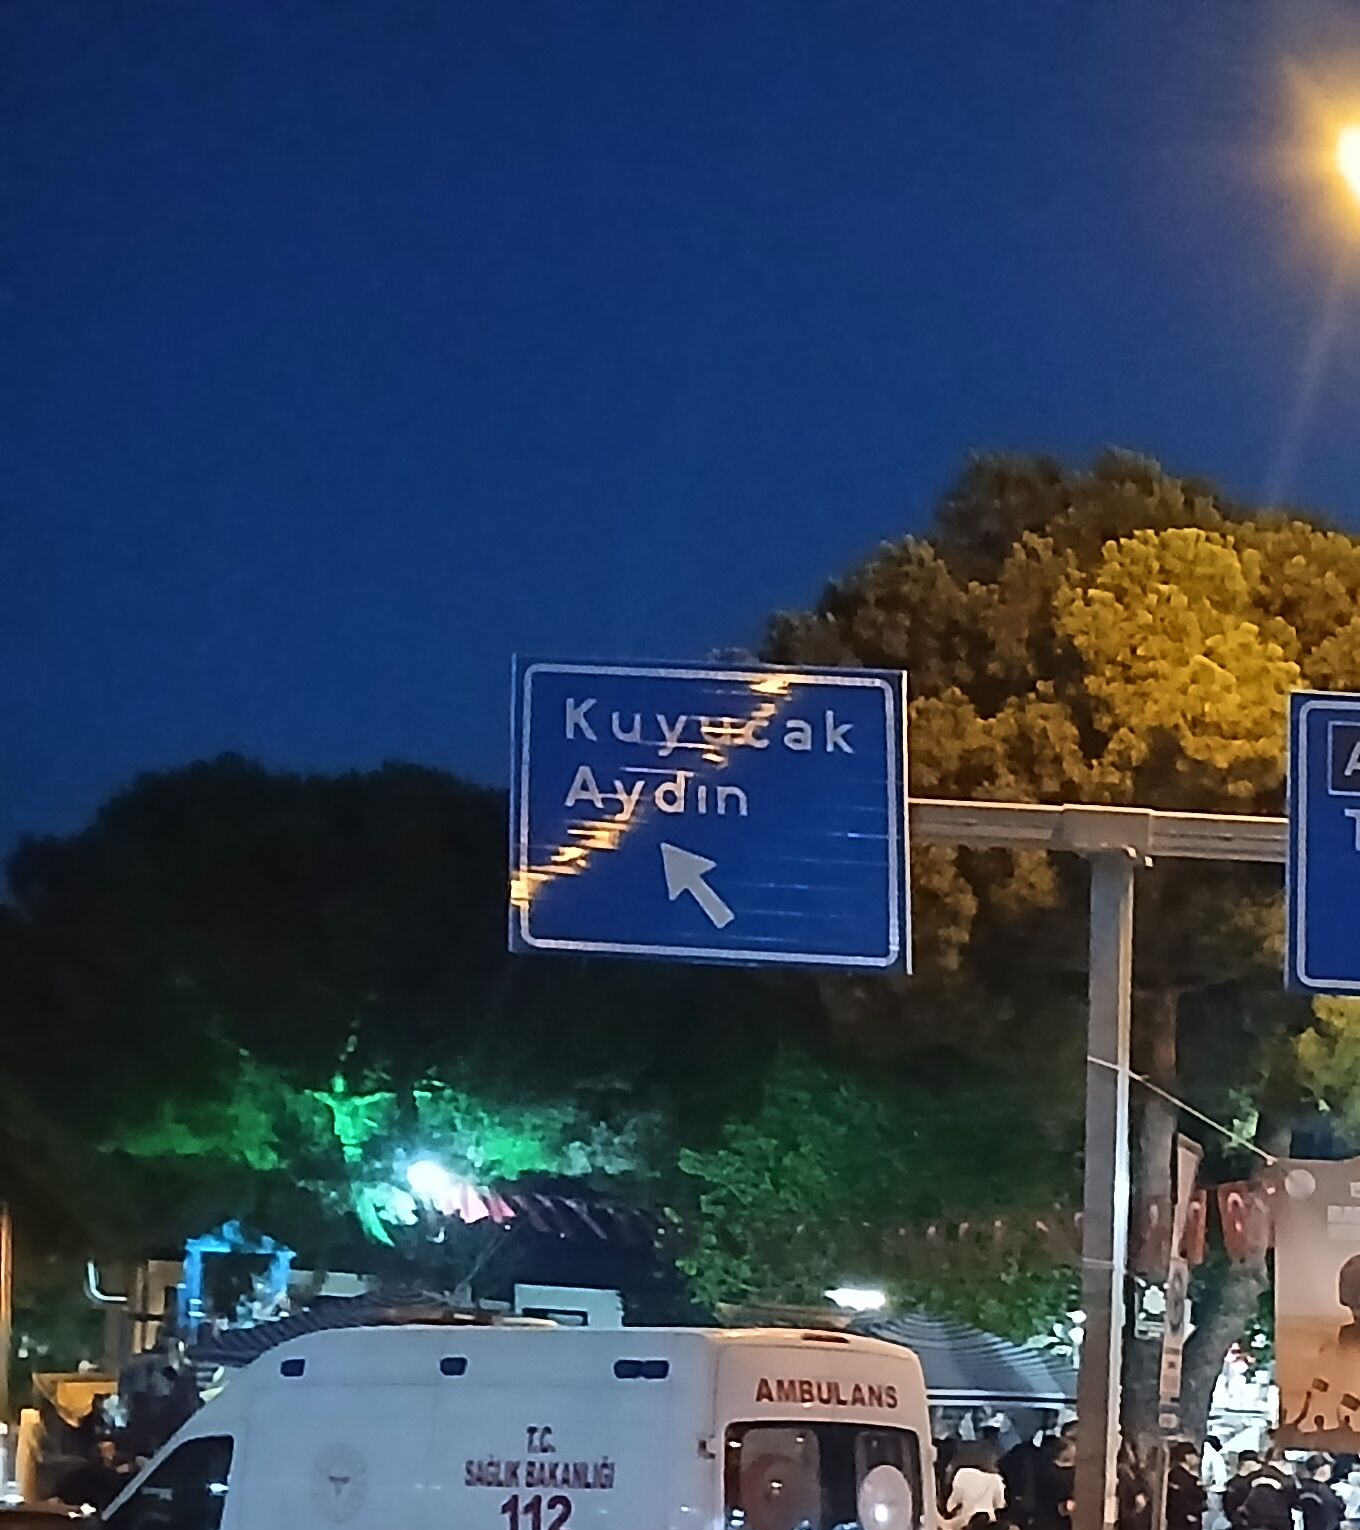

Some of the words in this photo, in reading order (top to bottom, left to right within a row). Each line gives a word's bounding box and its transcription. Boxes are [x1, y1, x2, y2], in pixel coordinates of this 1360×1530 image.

[564, 697, 855, 757] Kuyucak
[564, 765, 749, 821] Aydın
[755, 1377, 898, 1409] AMBULANS
